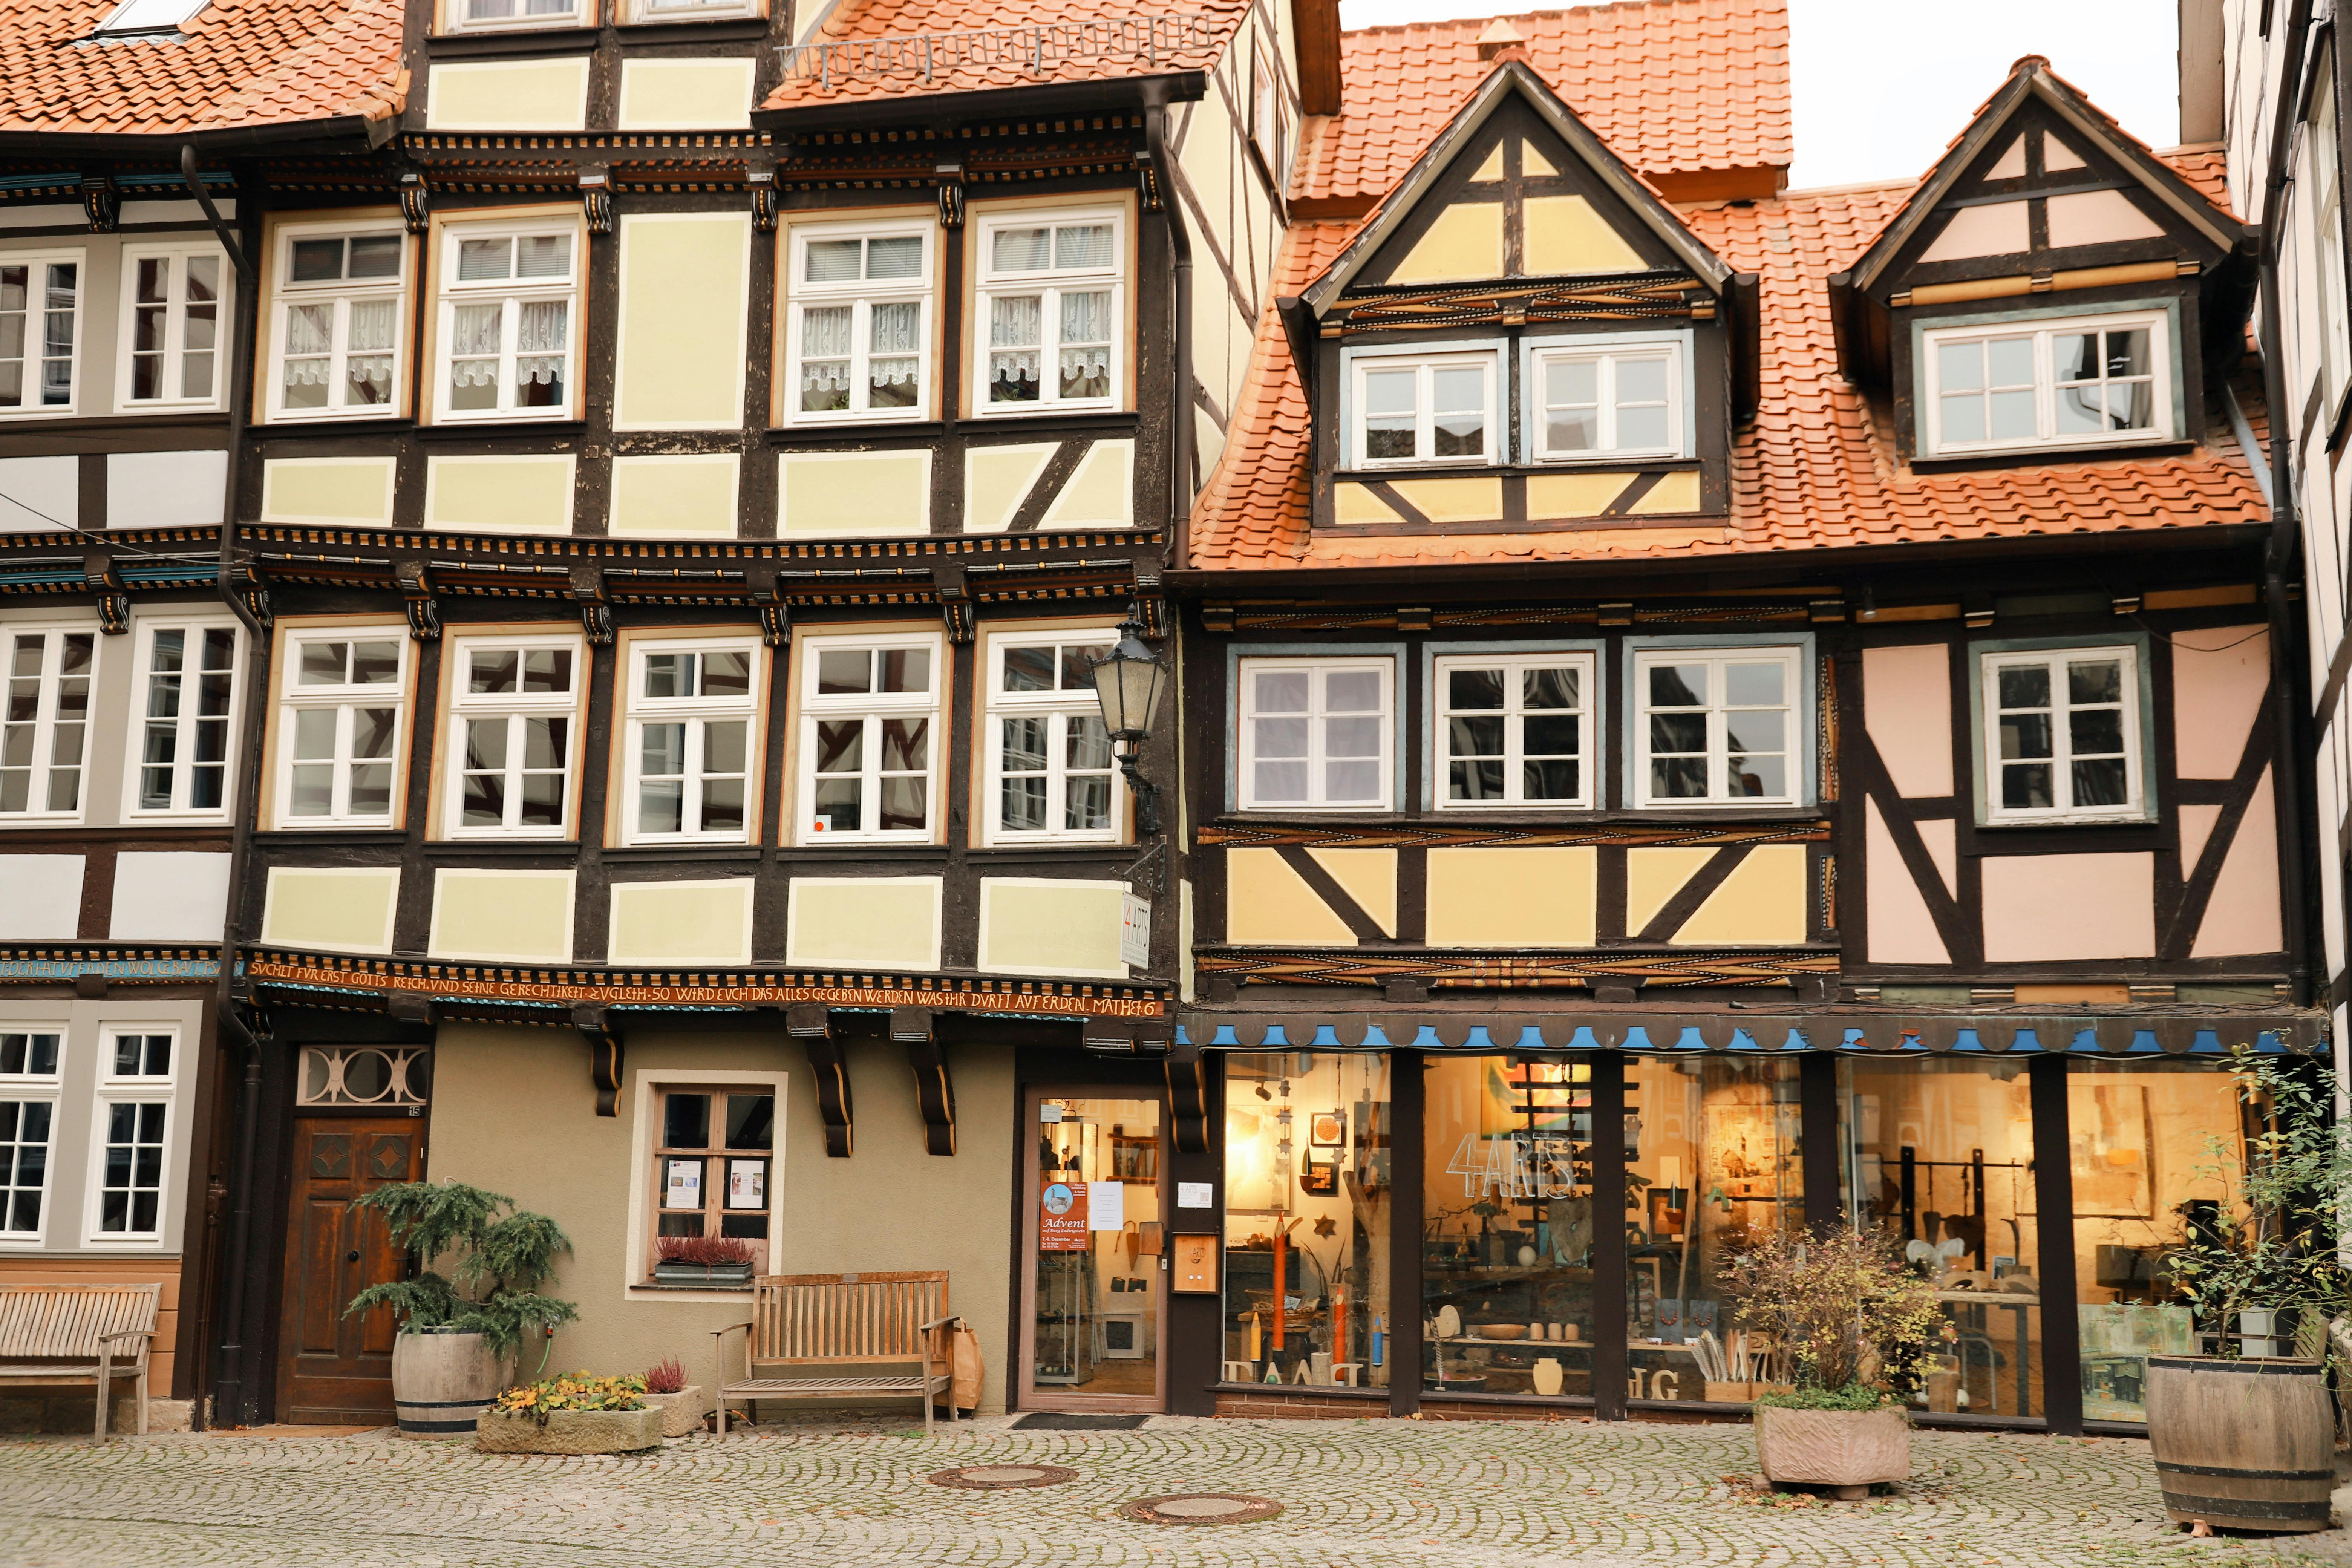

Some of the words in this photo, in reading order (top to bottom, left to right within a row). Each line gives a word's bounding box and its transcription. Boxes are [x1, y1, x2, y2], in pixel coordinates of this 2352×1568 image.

[1125, 903, 1130, 940] 4
[1131, 905, 1148, 948] ARTS
[250, 962, 294, 977] SVCHET
[296, 967, 319, 981] FVR
[320, 969, 348, 983] ERST
[351, 972, 388, 987] GOTTS
[430, 980, 459, 992] VND
[462, 981, 496, 994] SEINE
[652, 987, 670, 1000] SO
[675, 987, 715, 1001] WIRD
[717, 988, 748, 1001] EVCH
[752, 988, 773, 1001] DAS
[775, 988, 810, 1001] ALLES
[812, 988, 862, 1003] GEGEBEN
[863, 989, 914, 1004] WERDEN
[917, 991, 943, 1005] WAS
[971, 993, 1011, 1009] DVRFT
[1014, 995, 1041, 1009] AVF
[1185, 1185, 1197, 1194] ARTS
[1043, 1217, 1086, 1228] Advent
